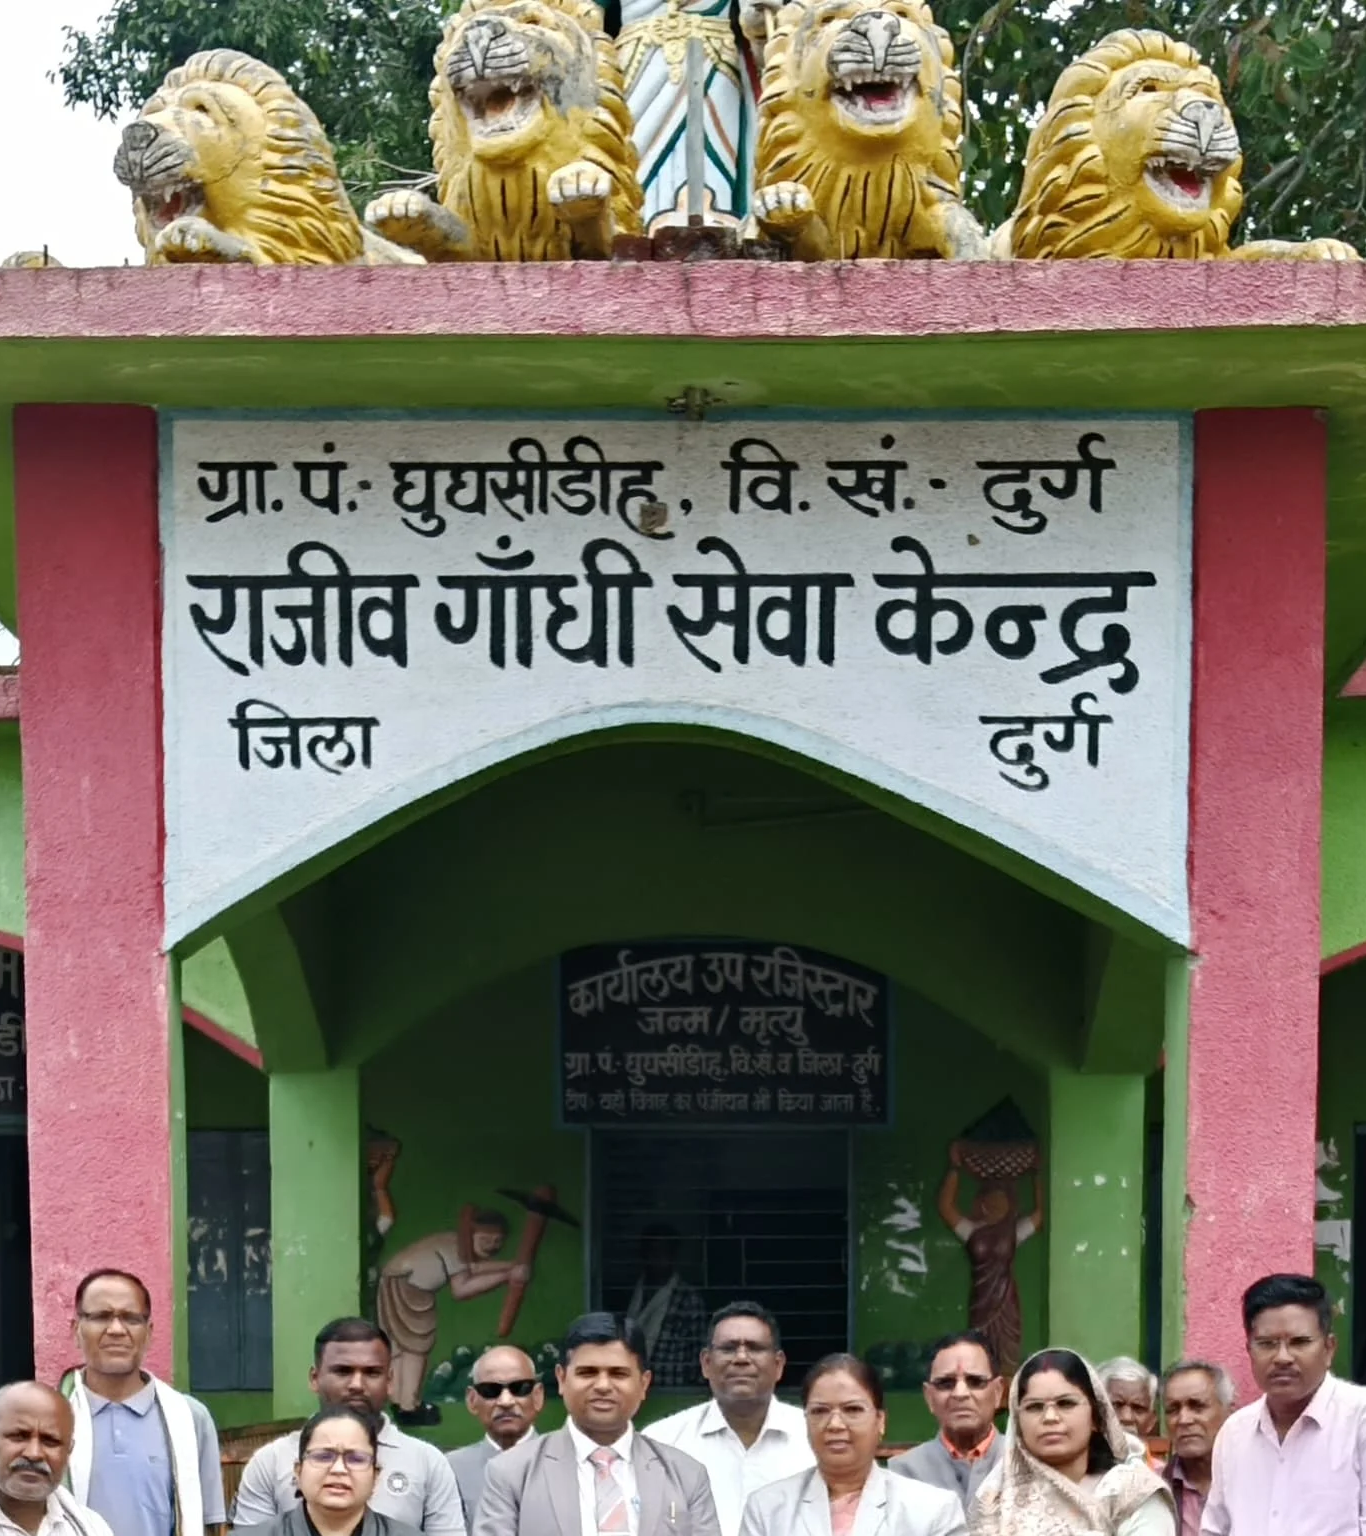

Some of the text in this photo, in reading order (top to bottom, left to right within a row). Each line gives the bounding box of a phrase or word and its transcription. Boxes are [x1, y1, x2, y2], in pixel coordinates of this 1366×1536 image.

[197, 461, 283, 522] ग्रा.
[722, 438, 810, 514] वि.
[974, 432, 1117, 534] दुर्ग
[186, 534, 1157, 694] राजीव गाँधी सेवा केन्द्र
[227, 699, 379, 775] जिला
[979, 692, 1113, 791] दुर्ग
[568, 947, 877, 1032] कार्यालय उप रजिस्ट्रार
[637, 1006, 712, 1034] जन्म
[739, 1006, 809, 1046] मृत्यु
